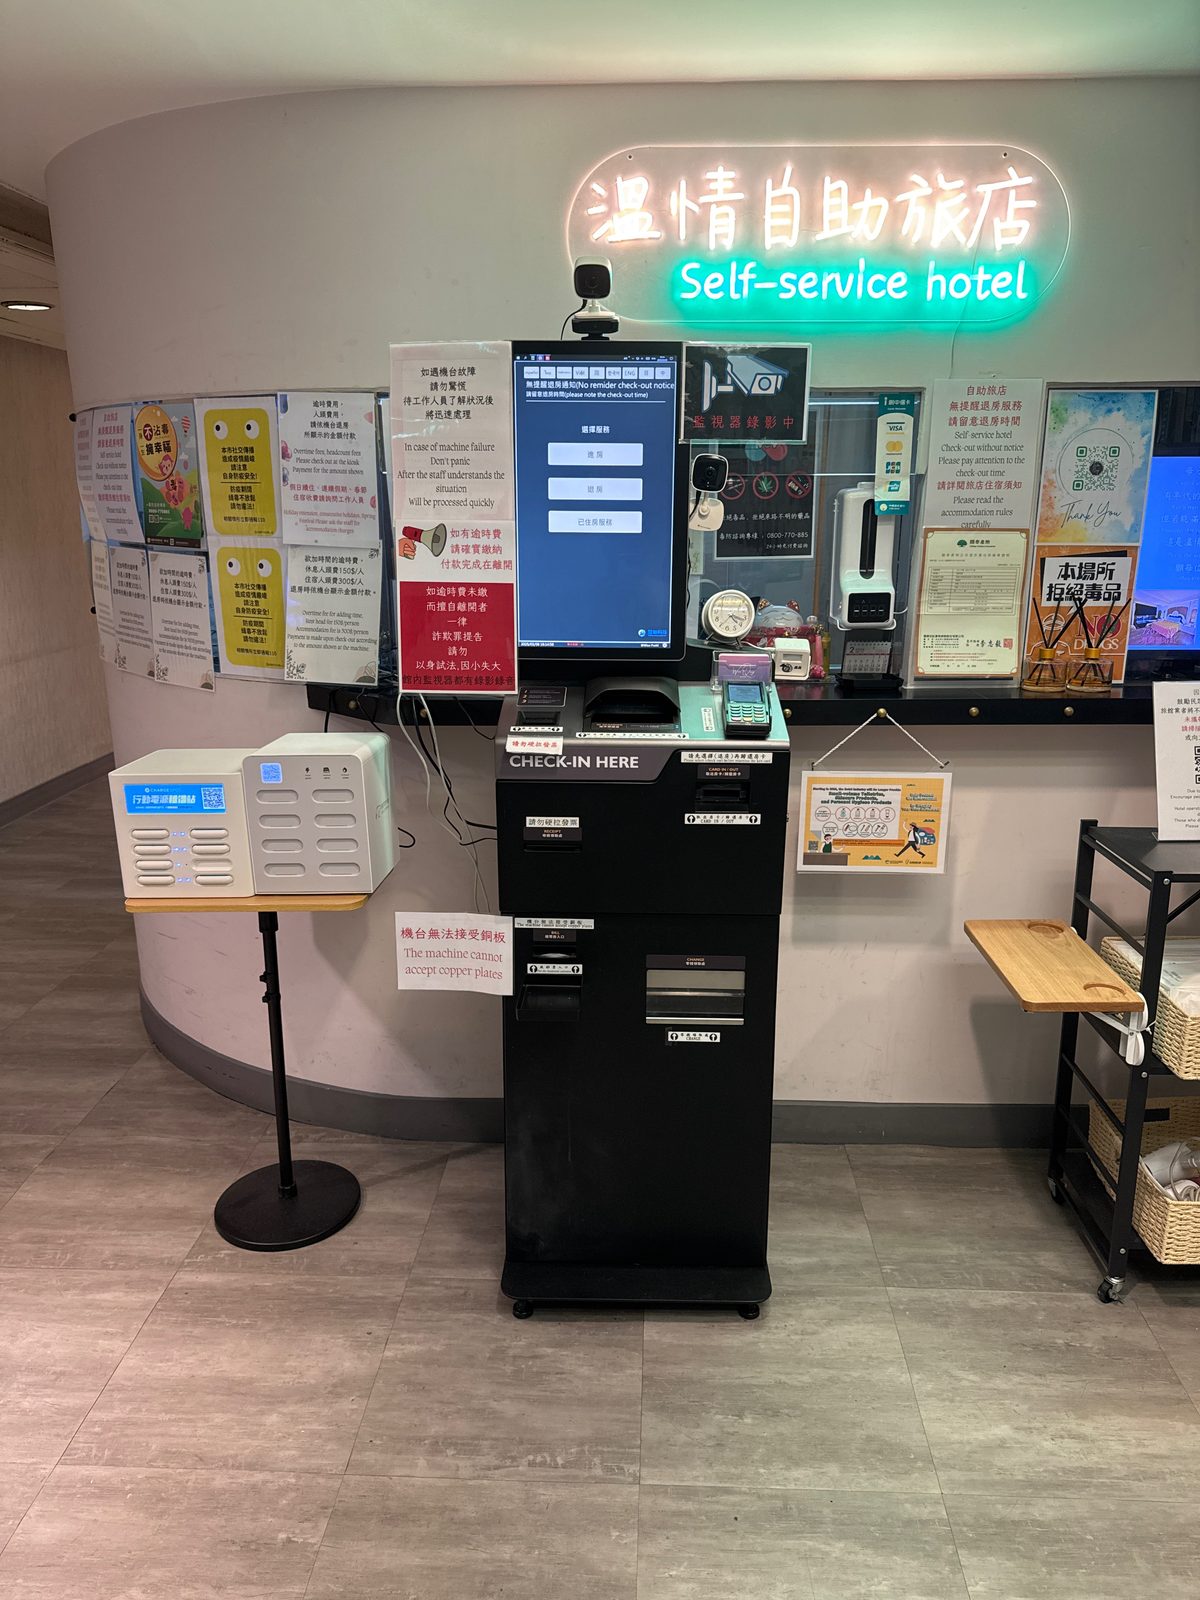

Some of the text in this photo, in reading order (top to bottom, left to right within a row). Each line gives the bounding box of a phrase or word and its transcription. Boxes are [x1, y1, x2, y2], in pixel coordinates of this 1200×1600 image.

[679, 257, 1028, 301] Self-service hotel
[420, 367, 476, 377] 如遇機台故障
[430, 381, 466, 392] 請勿驚慌
[618, 382, 652, 390] check-out
[967, 385, 1007, 396] 自助旅店
[403, 395, 494, 406] 待工作人員了解狀況後
[949, 401, 1022, 412] 無提醒退房服務
[425, 410, 472, 420] 將迅速處理
[310, 421, 349, 430] 請依機台退房
[948, 416, 1021, 427] 請留意退房時間
[303, 431, 357, 440] 所顯示的金額付款
[995, 431, 1012, 439] hotel
[326, 448, 350, 456] headcount
[404, 442, 412, 451] In
[430, 442, 438, 451] of
[439, 442, 470, 451] machine
[470, 442, 495, 451] failure
[941, 444, 1024, 452] Check-out without notice
[347, 458, 360, 466] kiosk
[450, 458, 470, 468] panic
[938, 456, 961, 464] Please
[961, 458, 973, 466] pay
[975, 456, 1005, 464] attention
[1014, 456, 1025, 464] the
[292, 467, 313, 475] Payment
[397, 470, 505, 480] After the staff understands the
[955, 469, 1006, 477] check-out time
[435, 484, 467, 493] situation
[937, 480, 1022, 491] 請詳閱旅店住宿須知
[408, 497, 495, 509] Will be processed quickly
[953, 496, 1004, 504] Please read the
[940, 508, 1013, 517] accommodation rules
[1061, 499, 1122, 528] Thank You
[961, 520, 991, 528] carefully
[450, 528, 501, 539] 如有逾時費
[450, 543, 503, 555] 請確實繳納
[305, 566, 365, 575] 休息人頭費150$/人
[441, 559, 512, 571] 付款完成在離開
[1057, 562, 1116, 581] 本場所
[304, 577, 364, 586] 住宿人頭費300$/人
[425, 586, 488, 597] 如逾時費未繳
[1046, 583, 1122, 602] 拒絕毒品
[426, 601, 488, 613] 而擅自離開者
[447, 616, 468, 627] 一律
[1076, 613, 1122, 638] NO
[431, 631, 484, 642] 詐欺罪提告
[447, 646, 468, 656] 請勿
[509, 755, 639, 769] CHECK-IN HERE
[400, 927, 506, 944] 機台無法接受銅板
[404, 948, 503, 962] The machine cannot
[405, 966, 503, 980] accept copper plates
